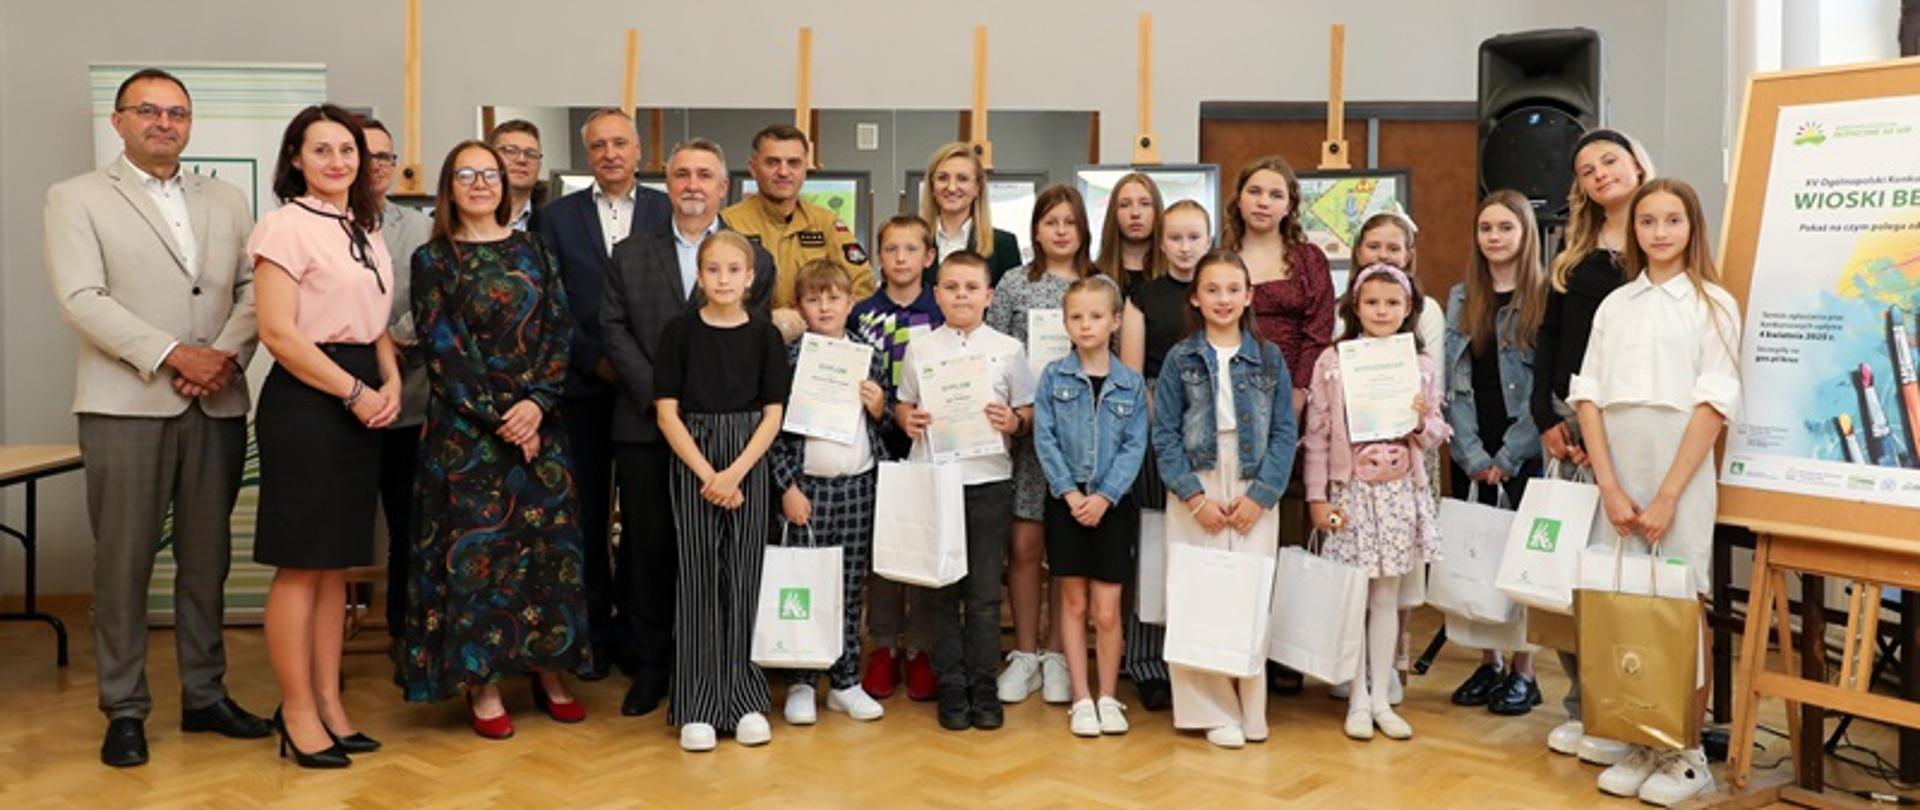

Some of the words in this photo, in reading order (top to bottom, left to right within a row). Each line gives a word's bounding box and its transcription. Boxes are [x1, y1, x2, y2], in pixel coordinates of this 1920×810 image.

[1794, 189, 1885, 210] WIOSKI
[1843, 223, 1869, 233] czym
[1871, 221, 1906, 232] polega
